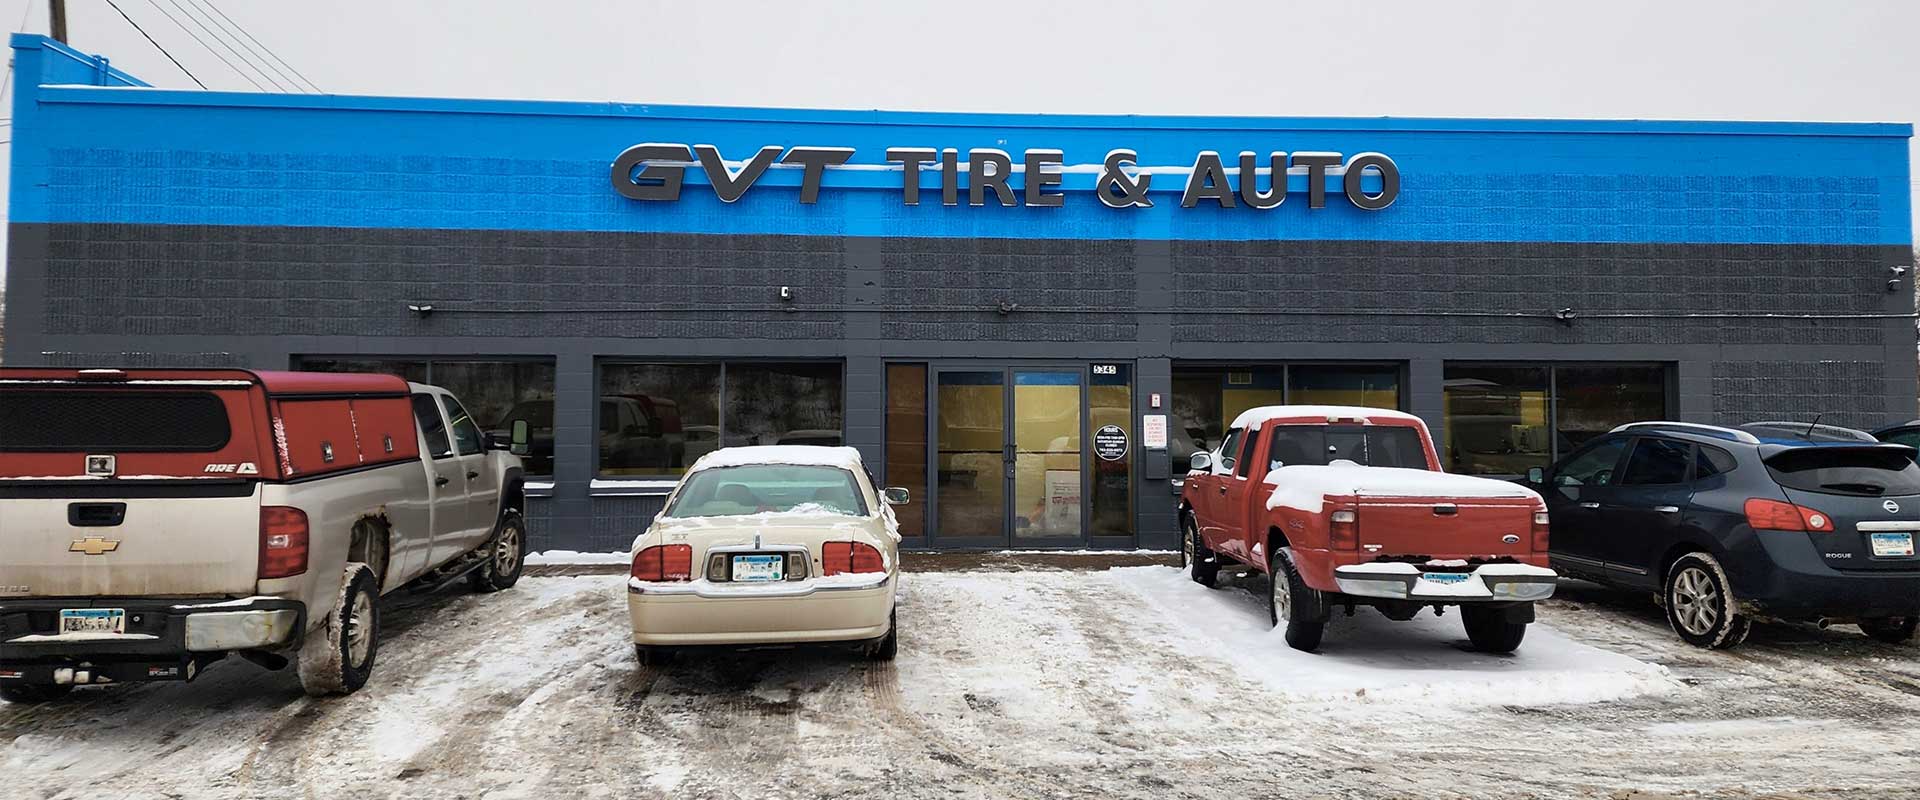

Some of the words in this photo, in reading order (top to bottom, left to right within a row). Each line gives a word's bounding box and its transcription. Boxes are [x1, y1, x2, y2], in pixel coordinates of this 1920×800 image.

[610, 142, 856, 205] GVT
[886, 147, 1066, 207] TIRE
[1096, 148, 1154, 208] &
[1180, 150, 1400, 210] AUTO
